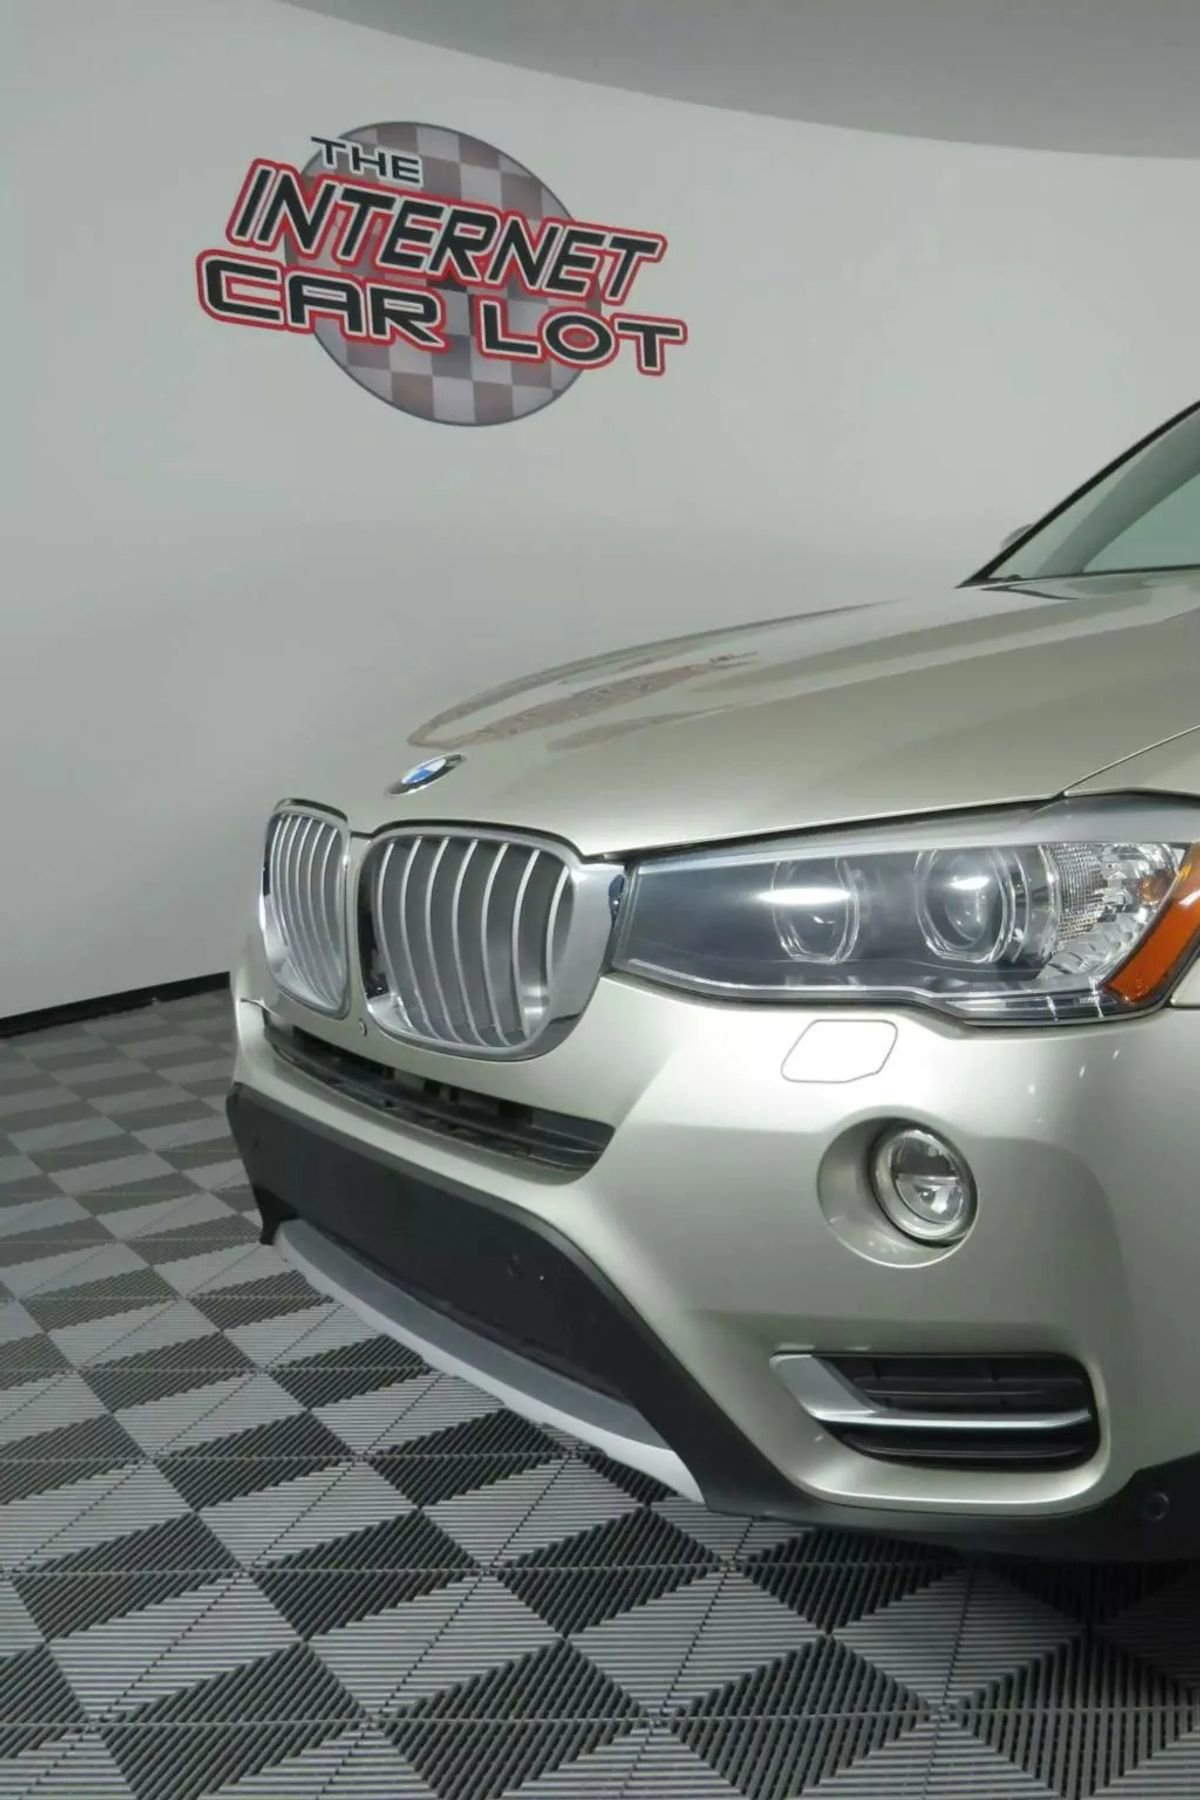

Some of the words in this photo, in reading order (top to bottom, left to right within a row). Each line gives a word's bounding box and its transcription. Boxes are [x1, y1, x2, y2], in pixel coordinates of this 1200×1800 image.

[311, 136, 421, 184] THE
[231, 163, 662, 302] INTERNET
[201, 254, 447, 349] CAR
[480, 300, 685, 370] LOT
